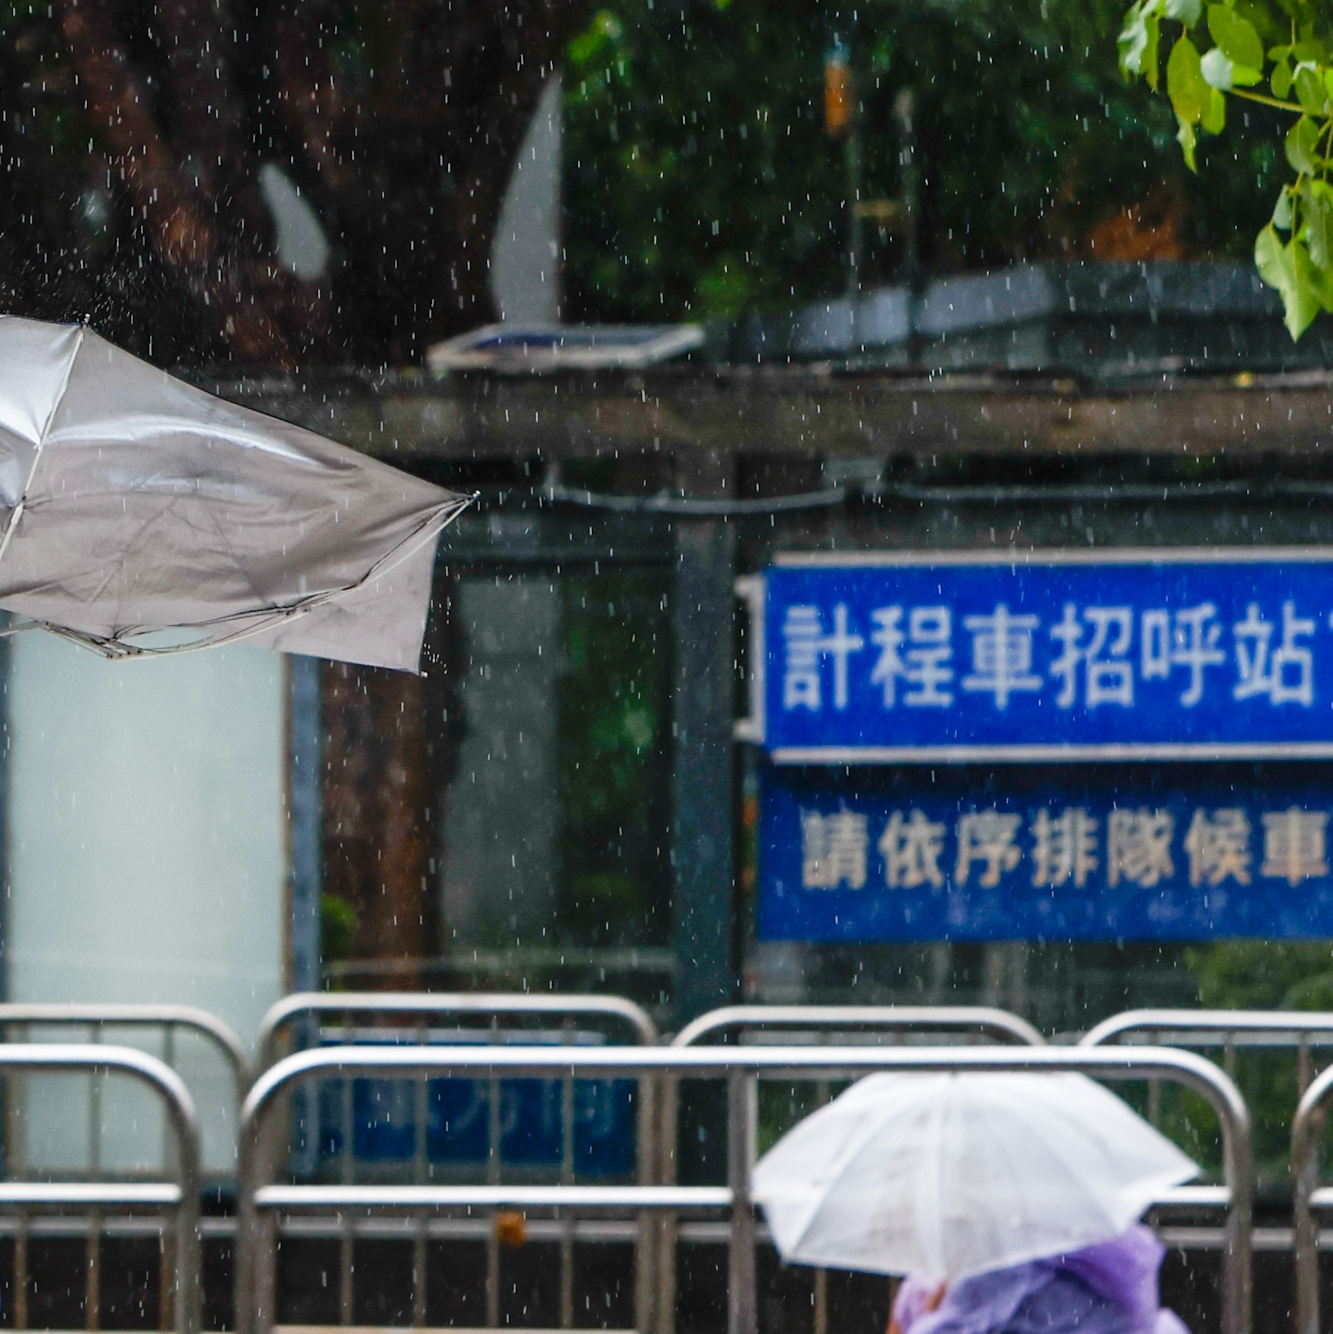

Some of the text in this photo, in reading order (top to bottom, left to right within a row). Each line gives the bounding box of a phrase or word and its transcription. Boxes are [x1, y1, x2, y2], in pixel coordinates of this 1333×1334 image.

[782, 602, 1317, 709] 計程車招呼站
[800, 806, 1331, 890] 請依序排隊候車
